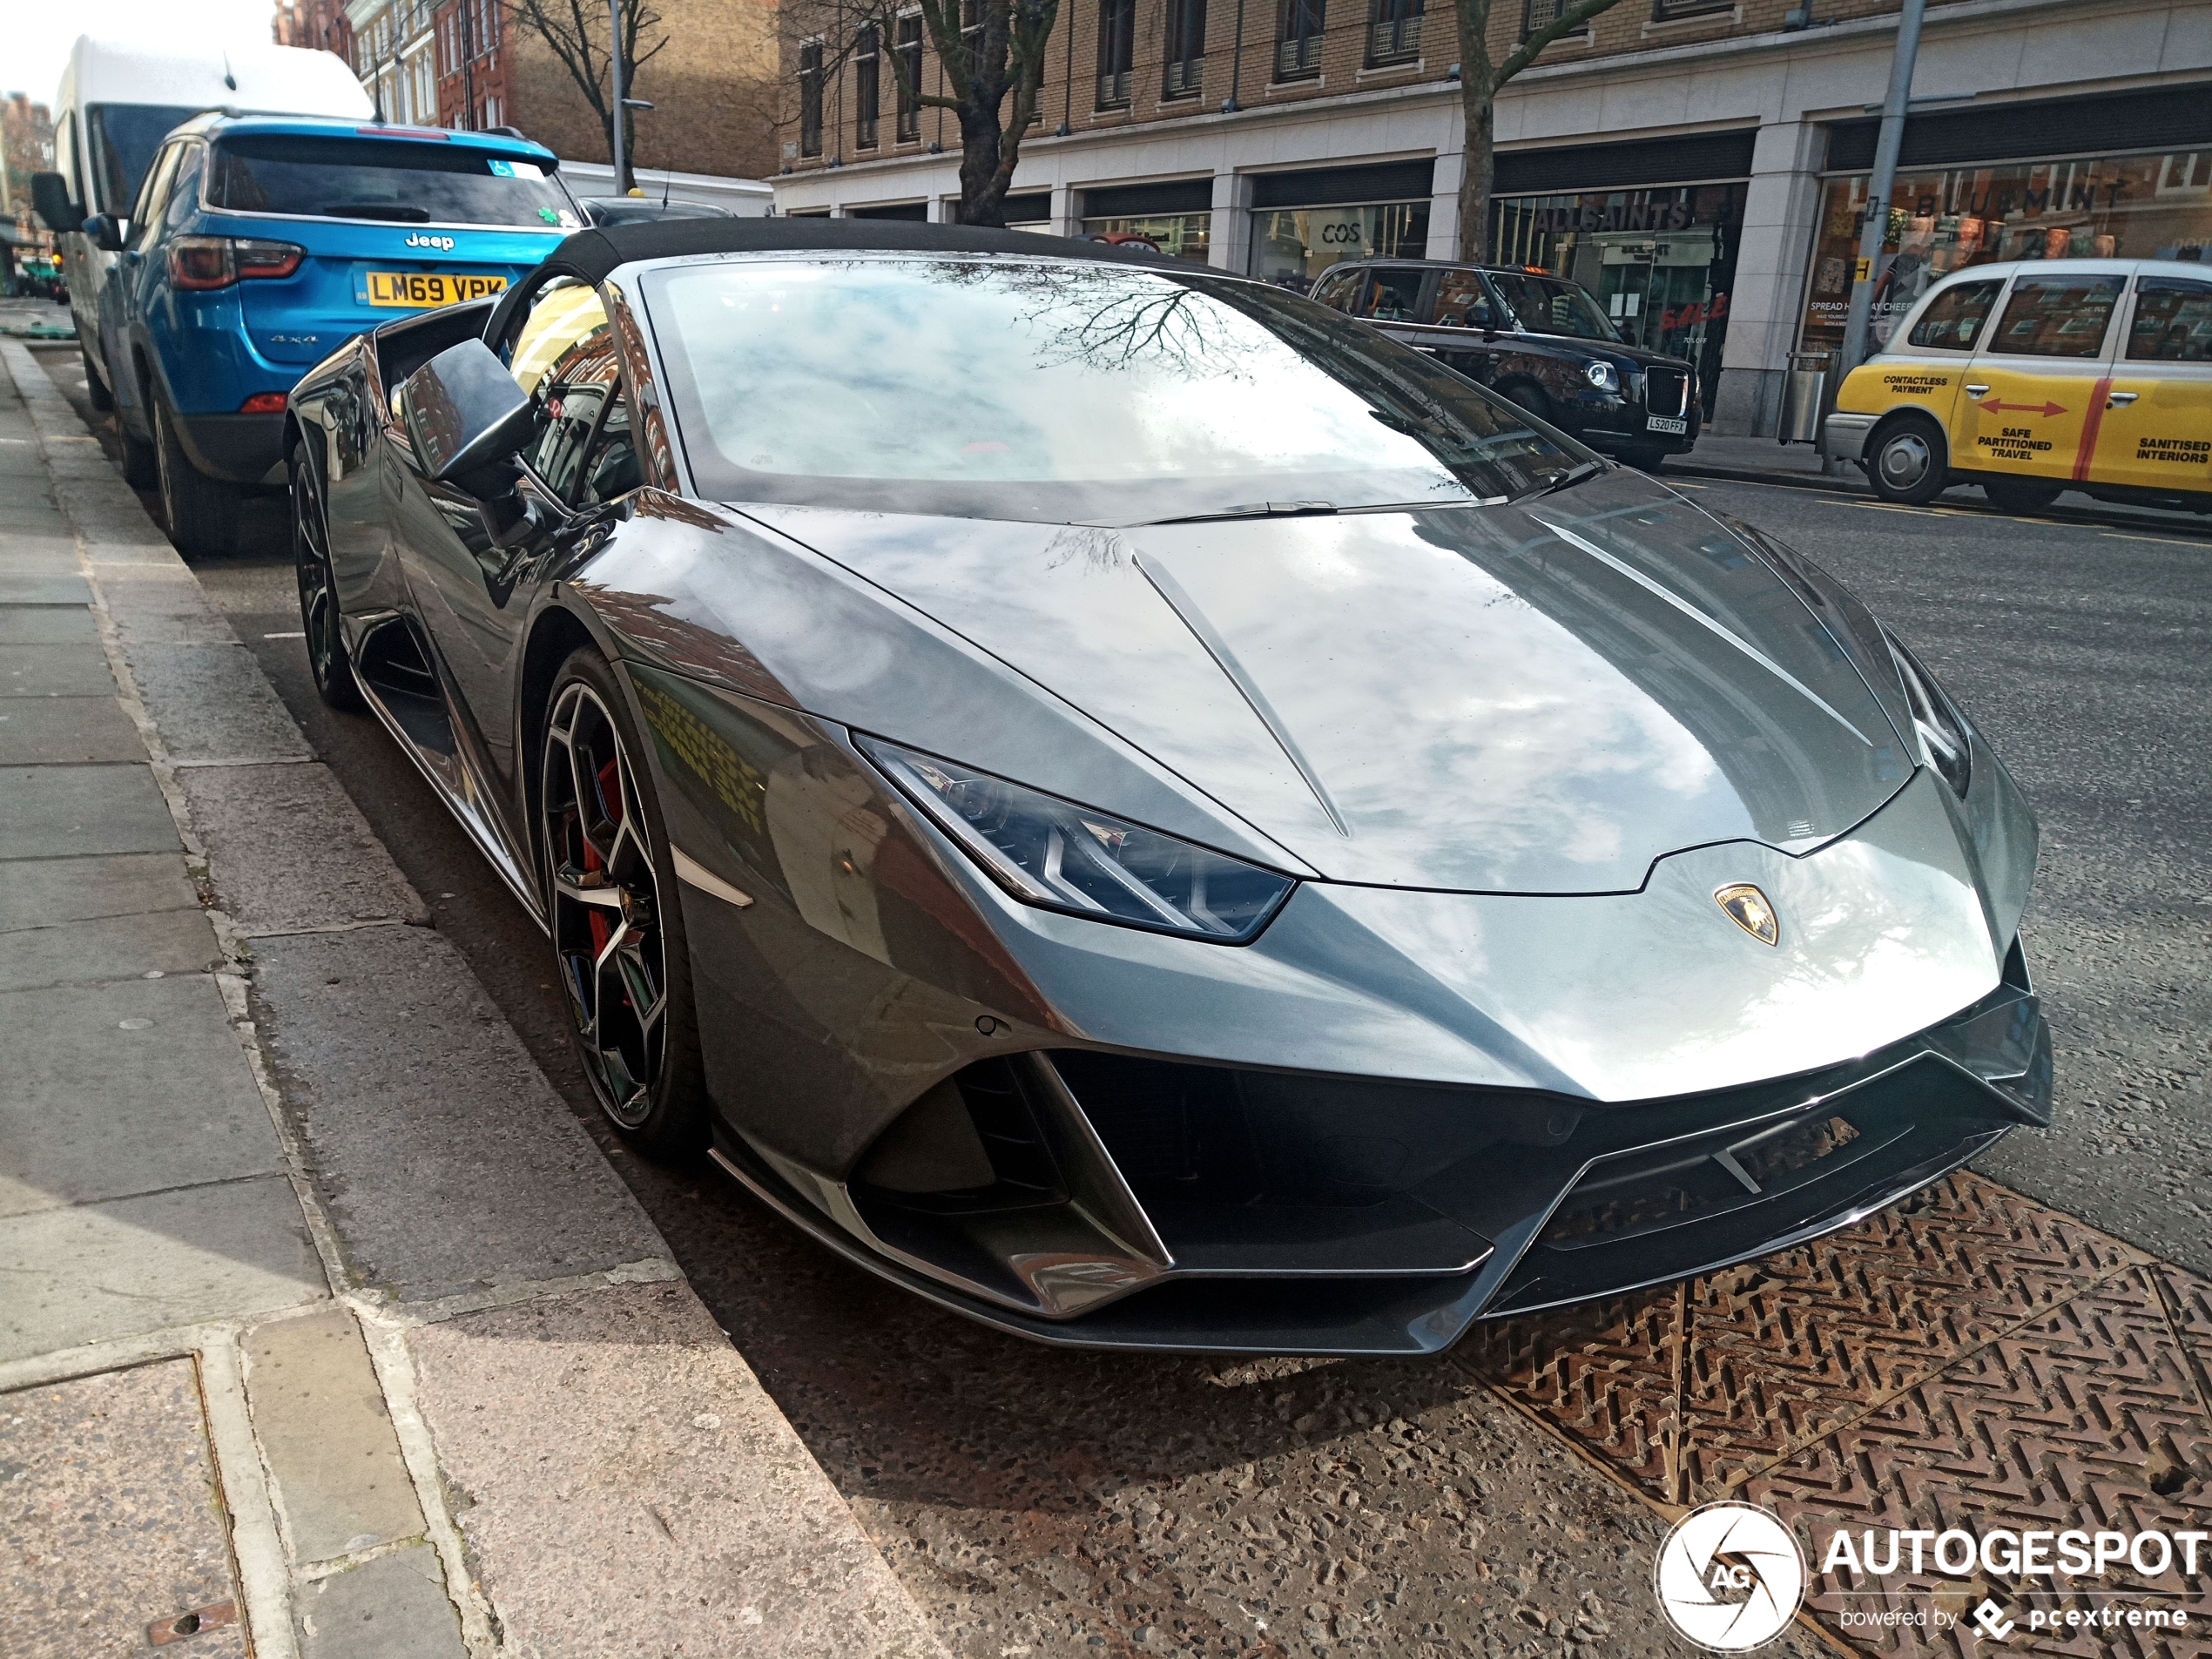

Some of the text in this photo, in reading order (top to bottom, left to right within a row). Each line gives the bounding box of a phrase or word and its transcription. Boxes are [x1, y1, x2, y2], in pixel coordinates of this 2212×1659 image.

[1915, 179, 2131, 217] BLUEMINT
[1534, 202, 1692, 233] ALLSAINTS
[1322, 222, 1360, 244] COS
[405, 233, 455, 251] Jeep
[372, 274, 445, 302] LM69
[1659, 294, 1728, 332] SALE
[1811, 301, 1844, 311] SPREAD
[1883, 375, 1948, 386] CONTACTLESS
[1891, 385, 1934, 395] PAYMENT
[1649, 419, 1685, 432] LS20 FFX
[2001, 428, 2032, 439] SAFE
[1977, 436, 2053, 451] PARTITIONED
[2139, 437, 2212, 452] SANITISED
[1991, 448, 2033, 460] TRAVEL
[2136, 449, 2209, 464] INTERIORS
